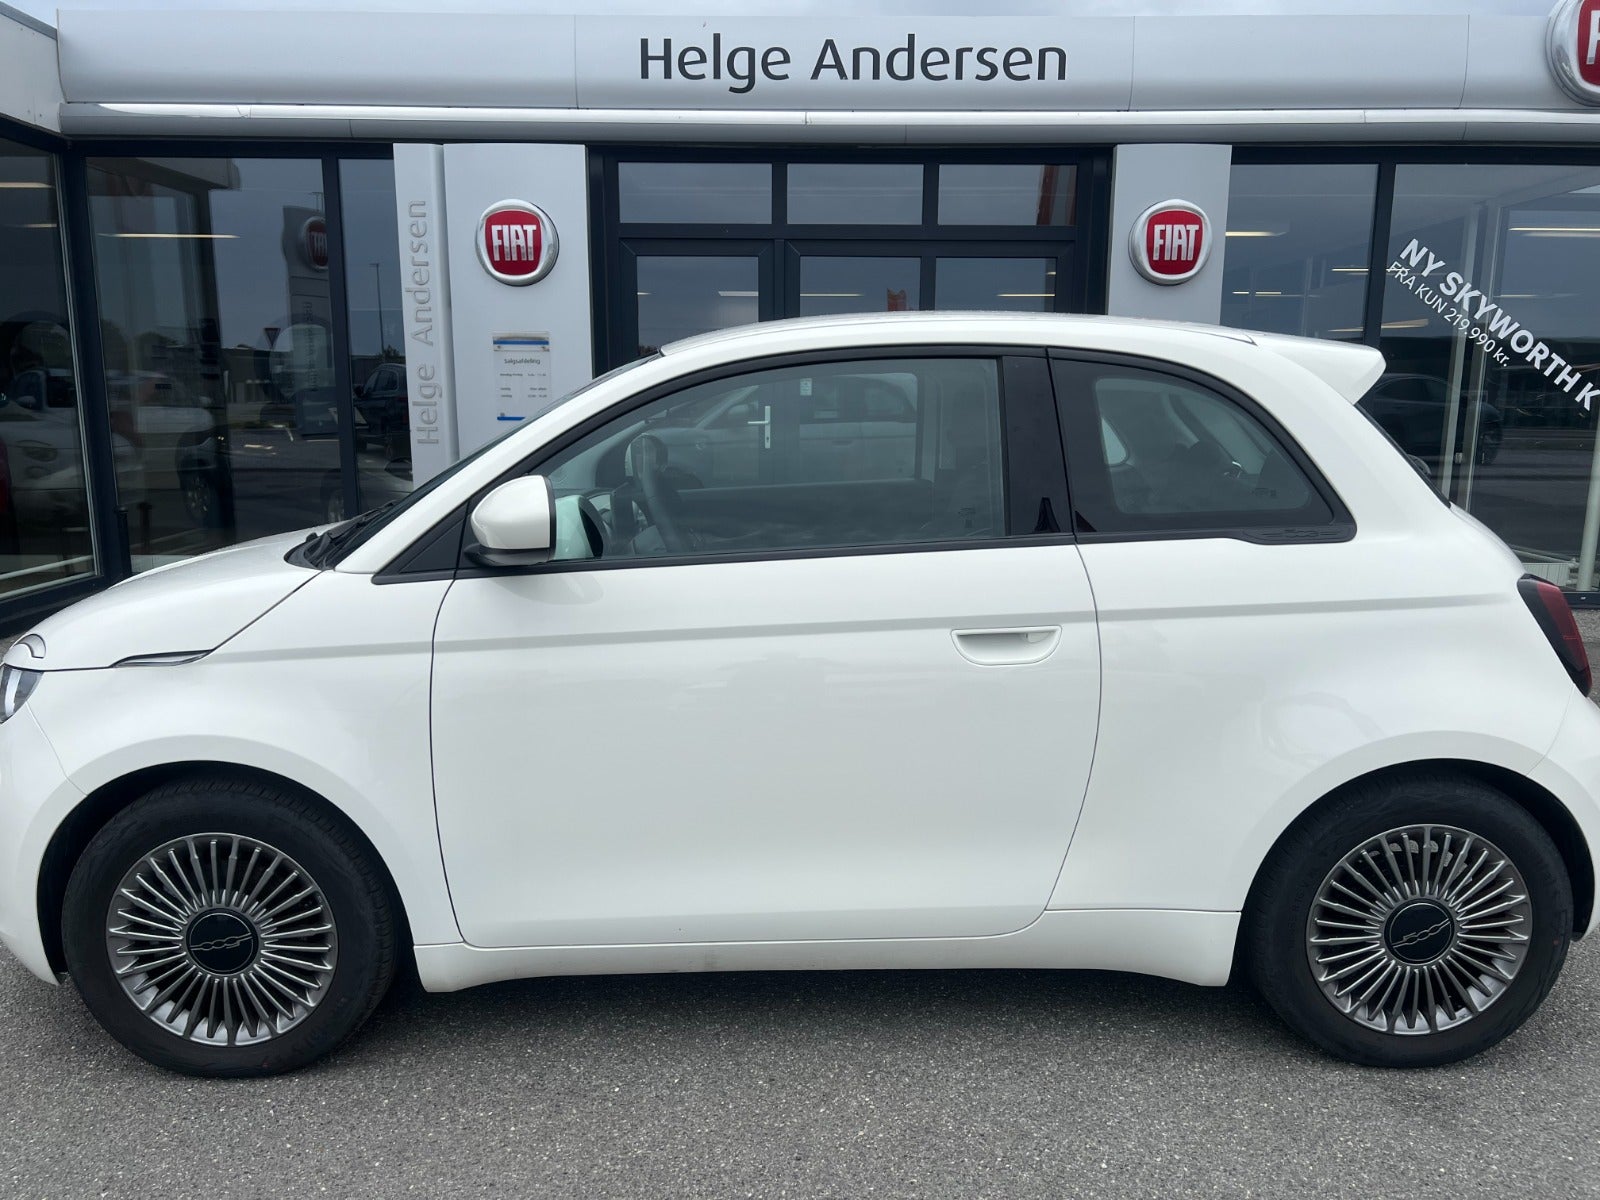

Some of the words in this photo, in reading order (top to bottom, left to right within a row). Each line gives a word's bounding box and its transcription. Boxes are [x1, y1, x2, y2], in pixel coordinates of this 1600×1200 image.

[640, 33, 791, 94] Helge
[810, 33, 1067, 81] Andersen
[404, 200, 434, 347] Andersen
[491, 224, 537, 262] FIAT
[1152, 223, 1200, 261] FIAT
[1386, 261, 1415, 290] FRA
[1414, 283, 1448, 314] KUN
[1443, 307, 1496, 352] 219.990
[1493, 346, 1510, 367] kr.
[1400, 238, 1446, 278] NY
[1439, 271, 1582, 393] SKYWORTH
[411, 362, 443, 445] Helge
